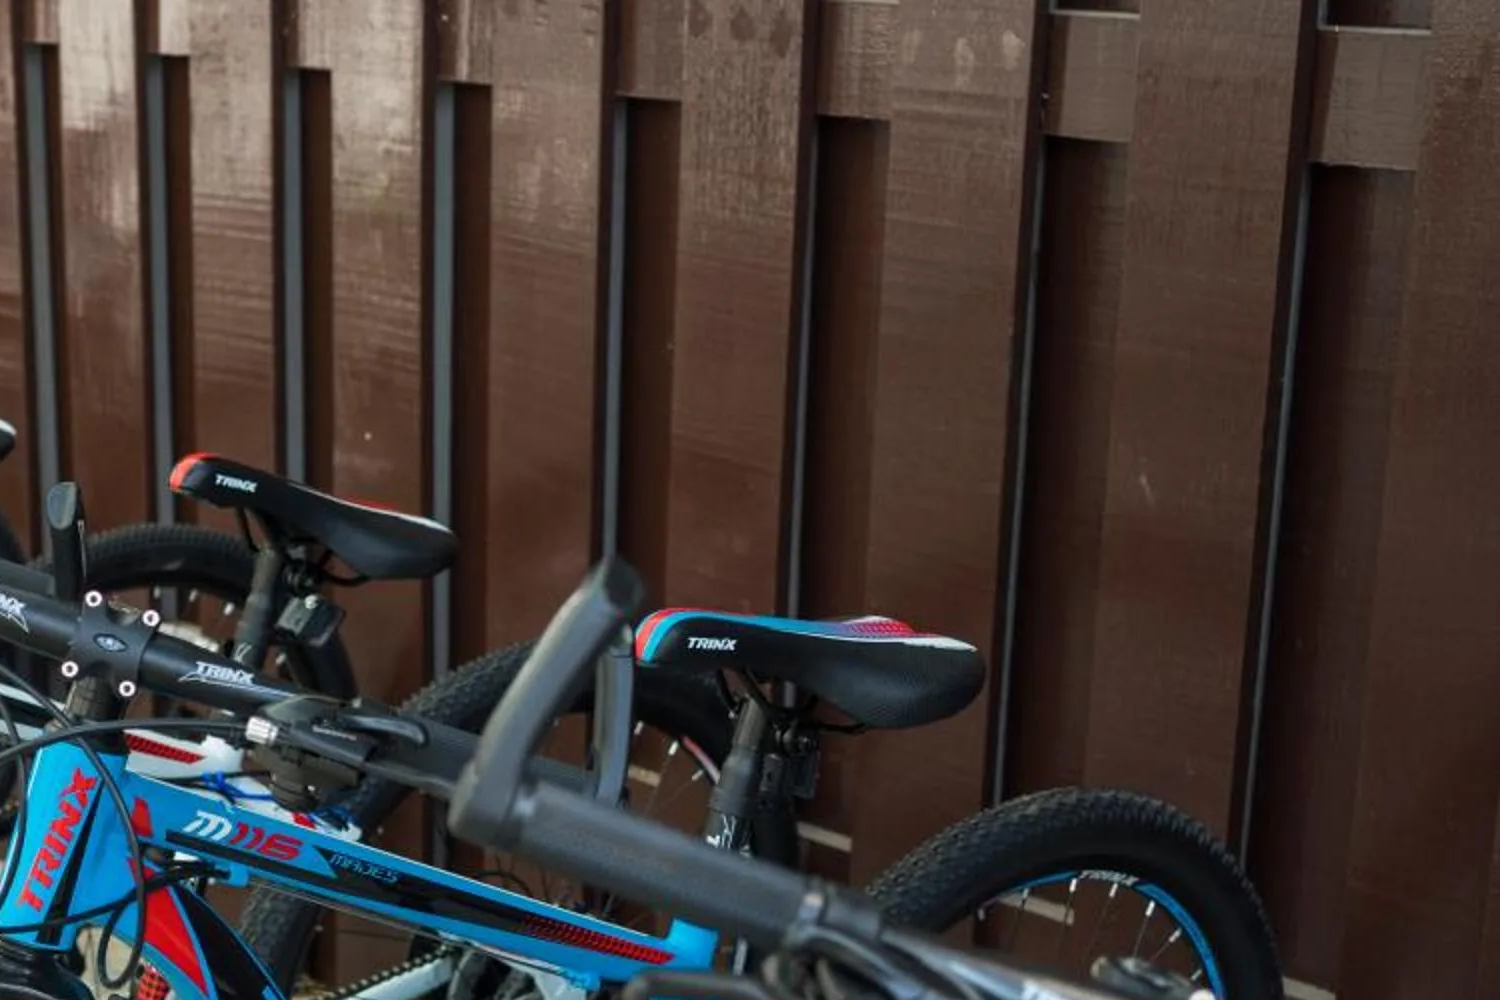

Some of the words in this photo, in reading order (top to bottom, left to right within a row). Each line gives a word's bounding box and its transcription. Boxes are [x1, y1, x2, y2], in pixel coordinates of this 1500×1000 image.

[215, 473, 258, 493] TRINX
[687, 636, 738, 651] TRINX
[196, 661, 254, 687] TRINX
[17, 766, 98, 912] TRINX
[182, 809, 304, 862] M116
